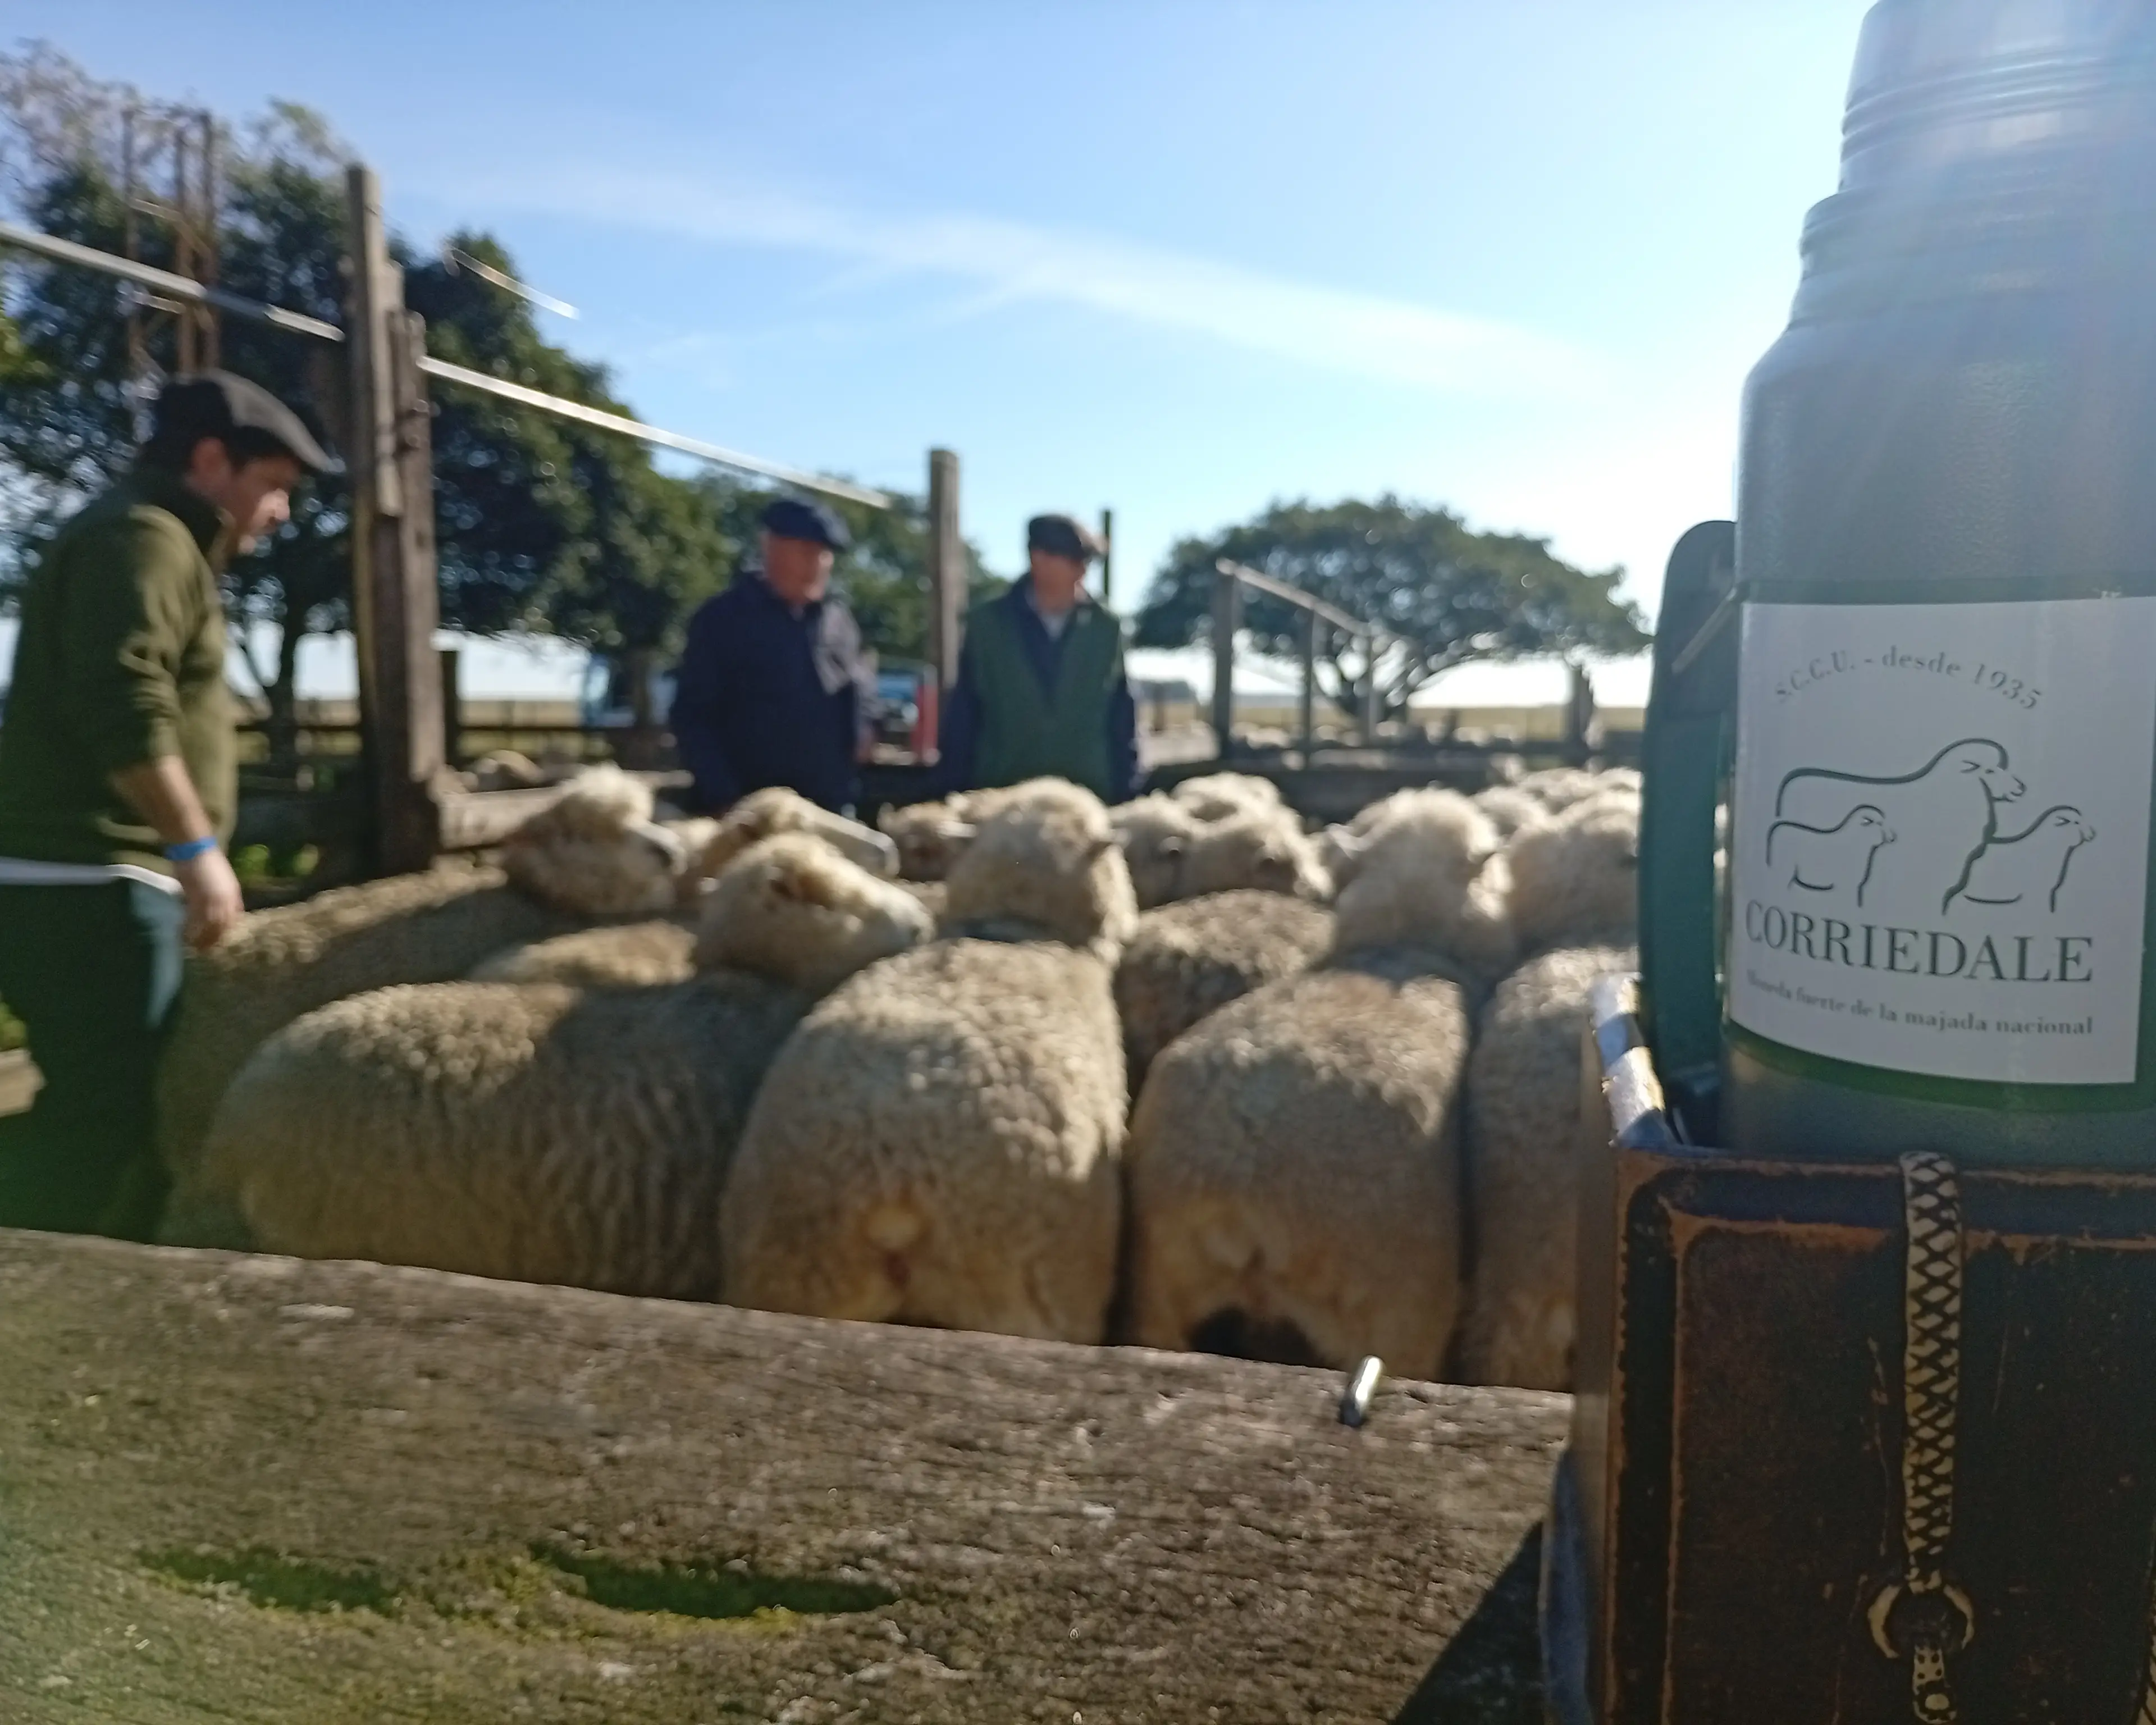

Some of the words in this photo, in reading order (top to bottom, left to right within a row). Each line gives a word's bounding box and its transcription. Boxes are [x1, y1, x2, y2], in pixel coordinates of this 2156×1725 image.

[1882, 644, 1961, 677] desde
[1974, 663, 2041, 709] 1935
[1745, 899, 2093, 982] CORRIEDALE
[1796, 987, 1846, 1011] fuerte
[1851, 998, 1872, 1017] de
[1879, 1002, 1897, 1022] la
[1905, 1011, 1988, 1032] majada
[1996, 1016, 2093, 1034] nacional
